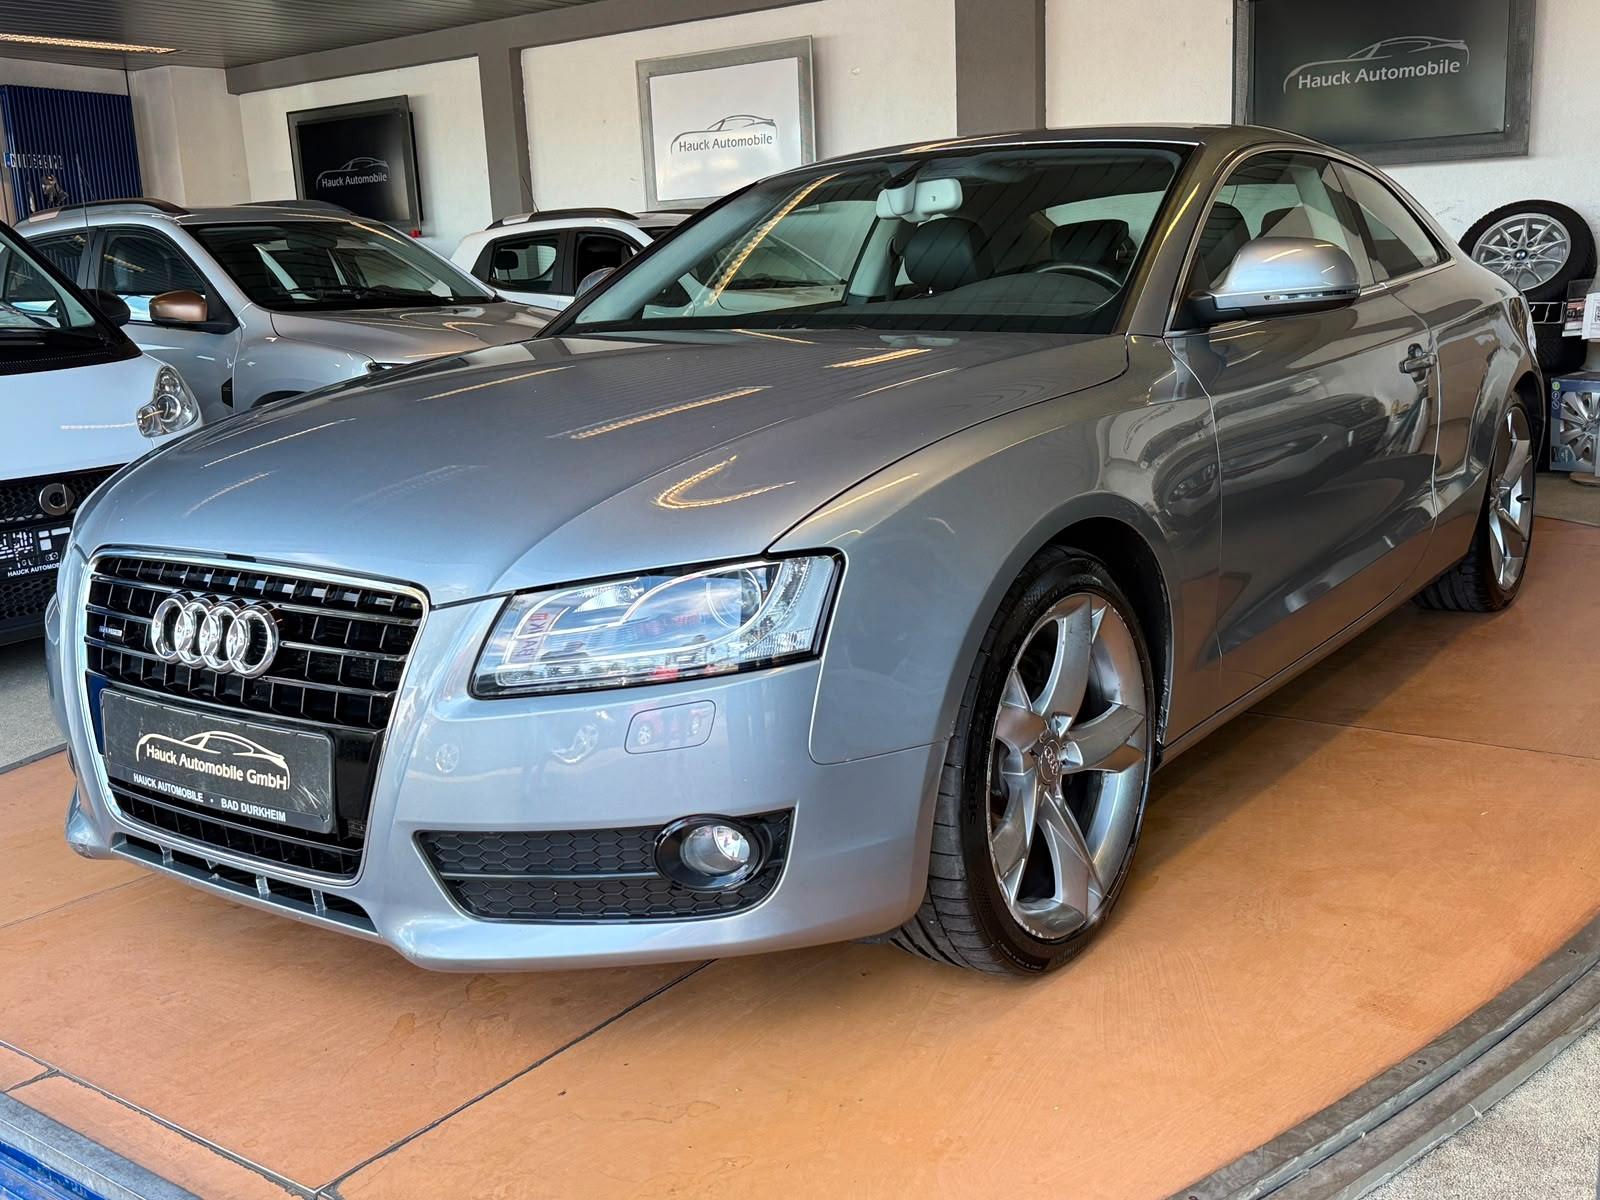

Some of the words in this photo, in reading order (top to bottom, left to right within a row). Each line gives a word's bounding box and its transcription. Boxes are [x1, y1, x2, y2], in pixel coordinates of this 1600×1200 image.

[1298, 70, 1351, 89] Hauck
[1354, 59, 1460, 84] Automobile
[679, 139, 710, 152] Hauck
[712, 133, 773, 149] Automobile
[321, 177, 344, 188] Hauck
[345, 172, 387, 185] Automobile
[7, 568, 29, 578] HAUCK
[146, 743, 178, 765] Hauck
[179, 753, 244, 781] Automobile
[246, 768, 287, 791] GmbH
[133, 772, 157, 789] HAUCK
[157, 781, 204, 803] AUTOMOBILE
[221, 797, 239, 811] BAD
